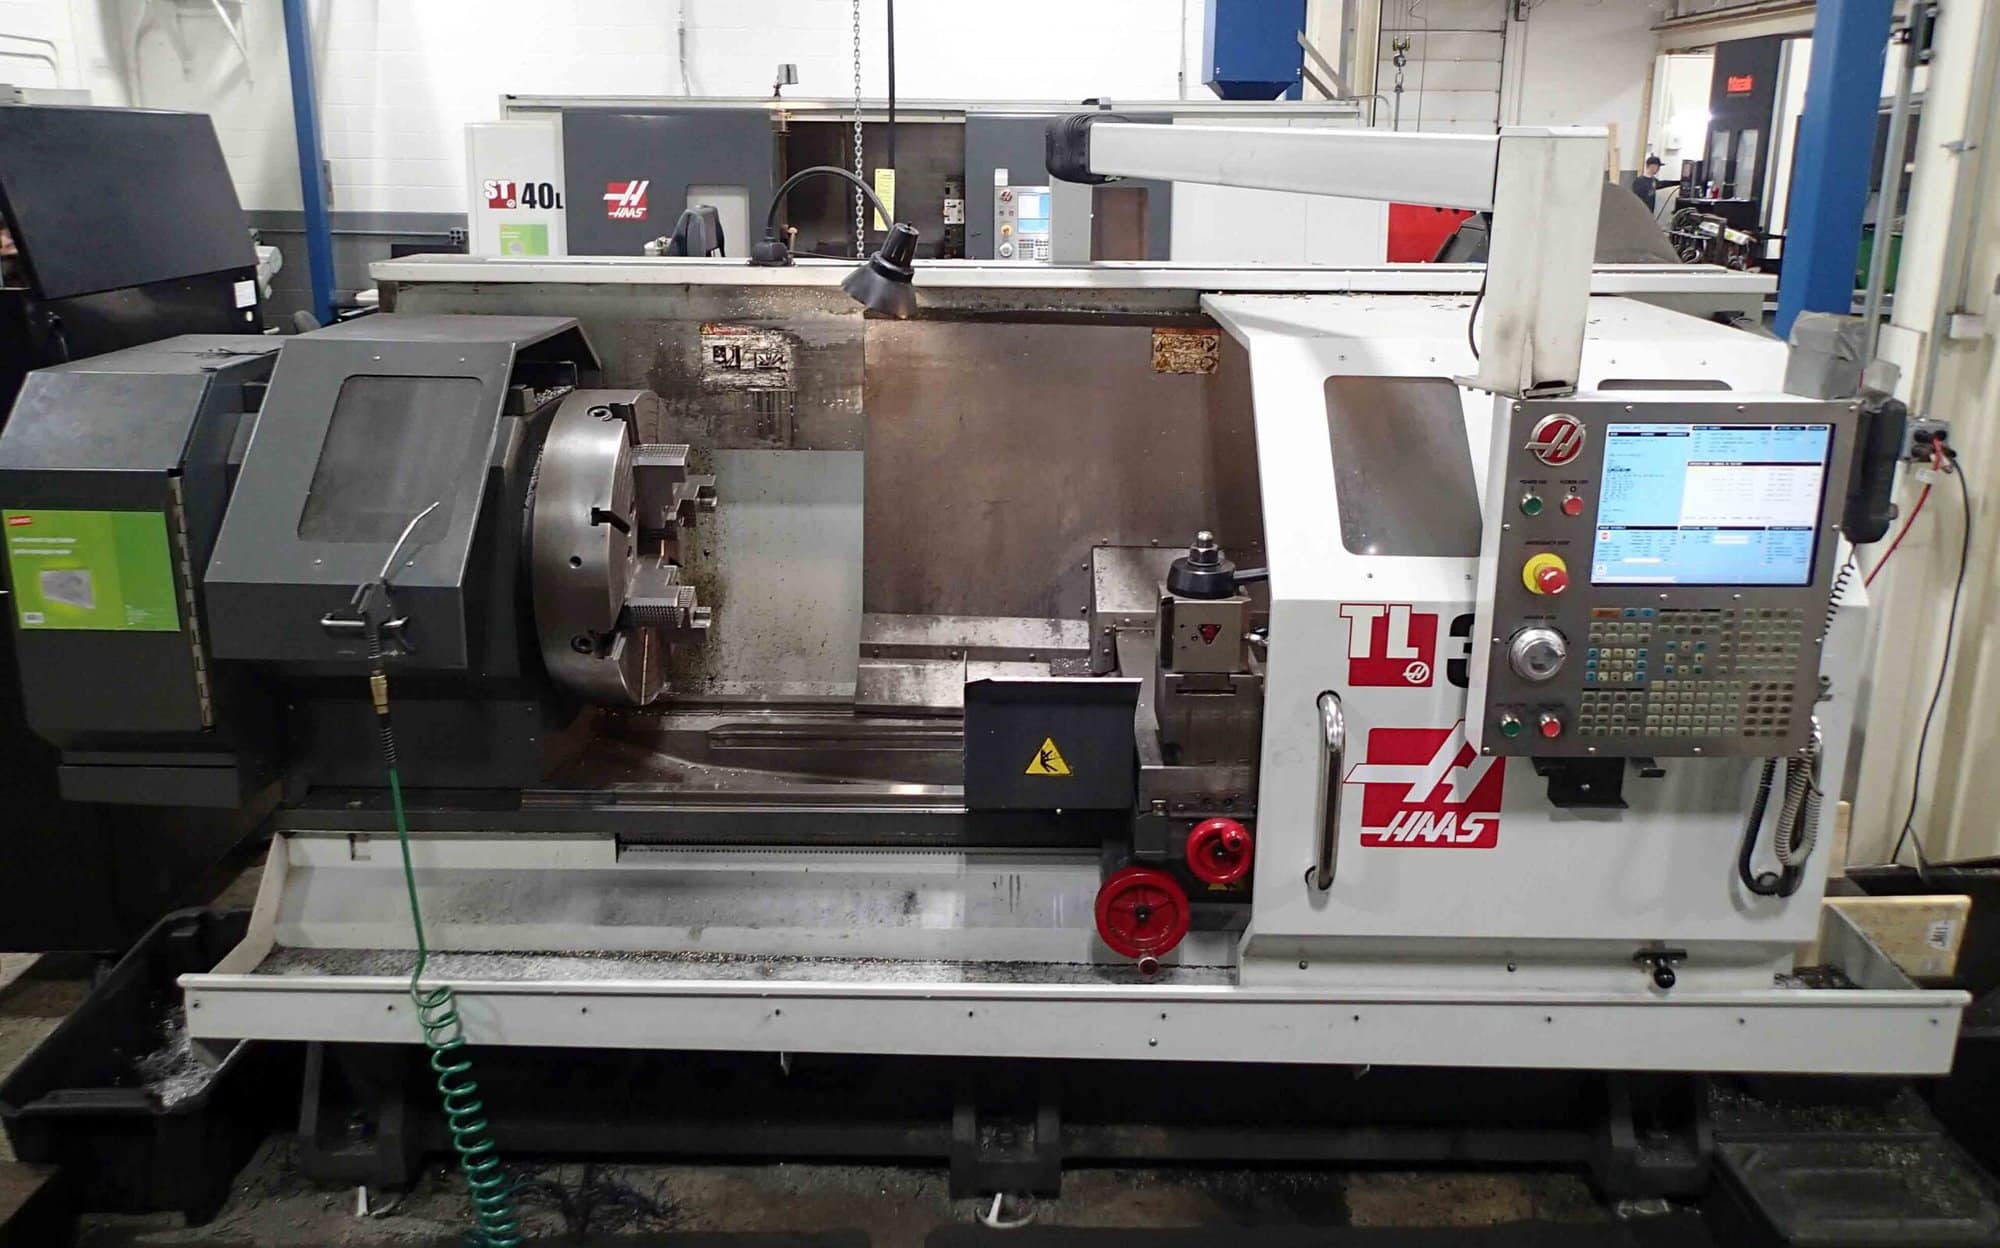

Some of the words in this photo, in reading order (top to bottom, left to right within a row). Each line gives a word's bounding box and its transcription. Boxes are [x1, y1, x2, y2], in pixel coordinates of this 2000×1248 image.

[484, 179, 511, 199] ST
[608, 208, 647, 218] HAAS
[1340, 603, 1419, 659] TL
[1360, 811, 1501, 843] HAAS
